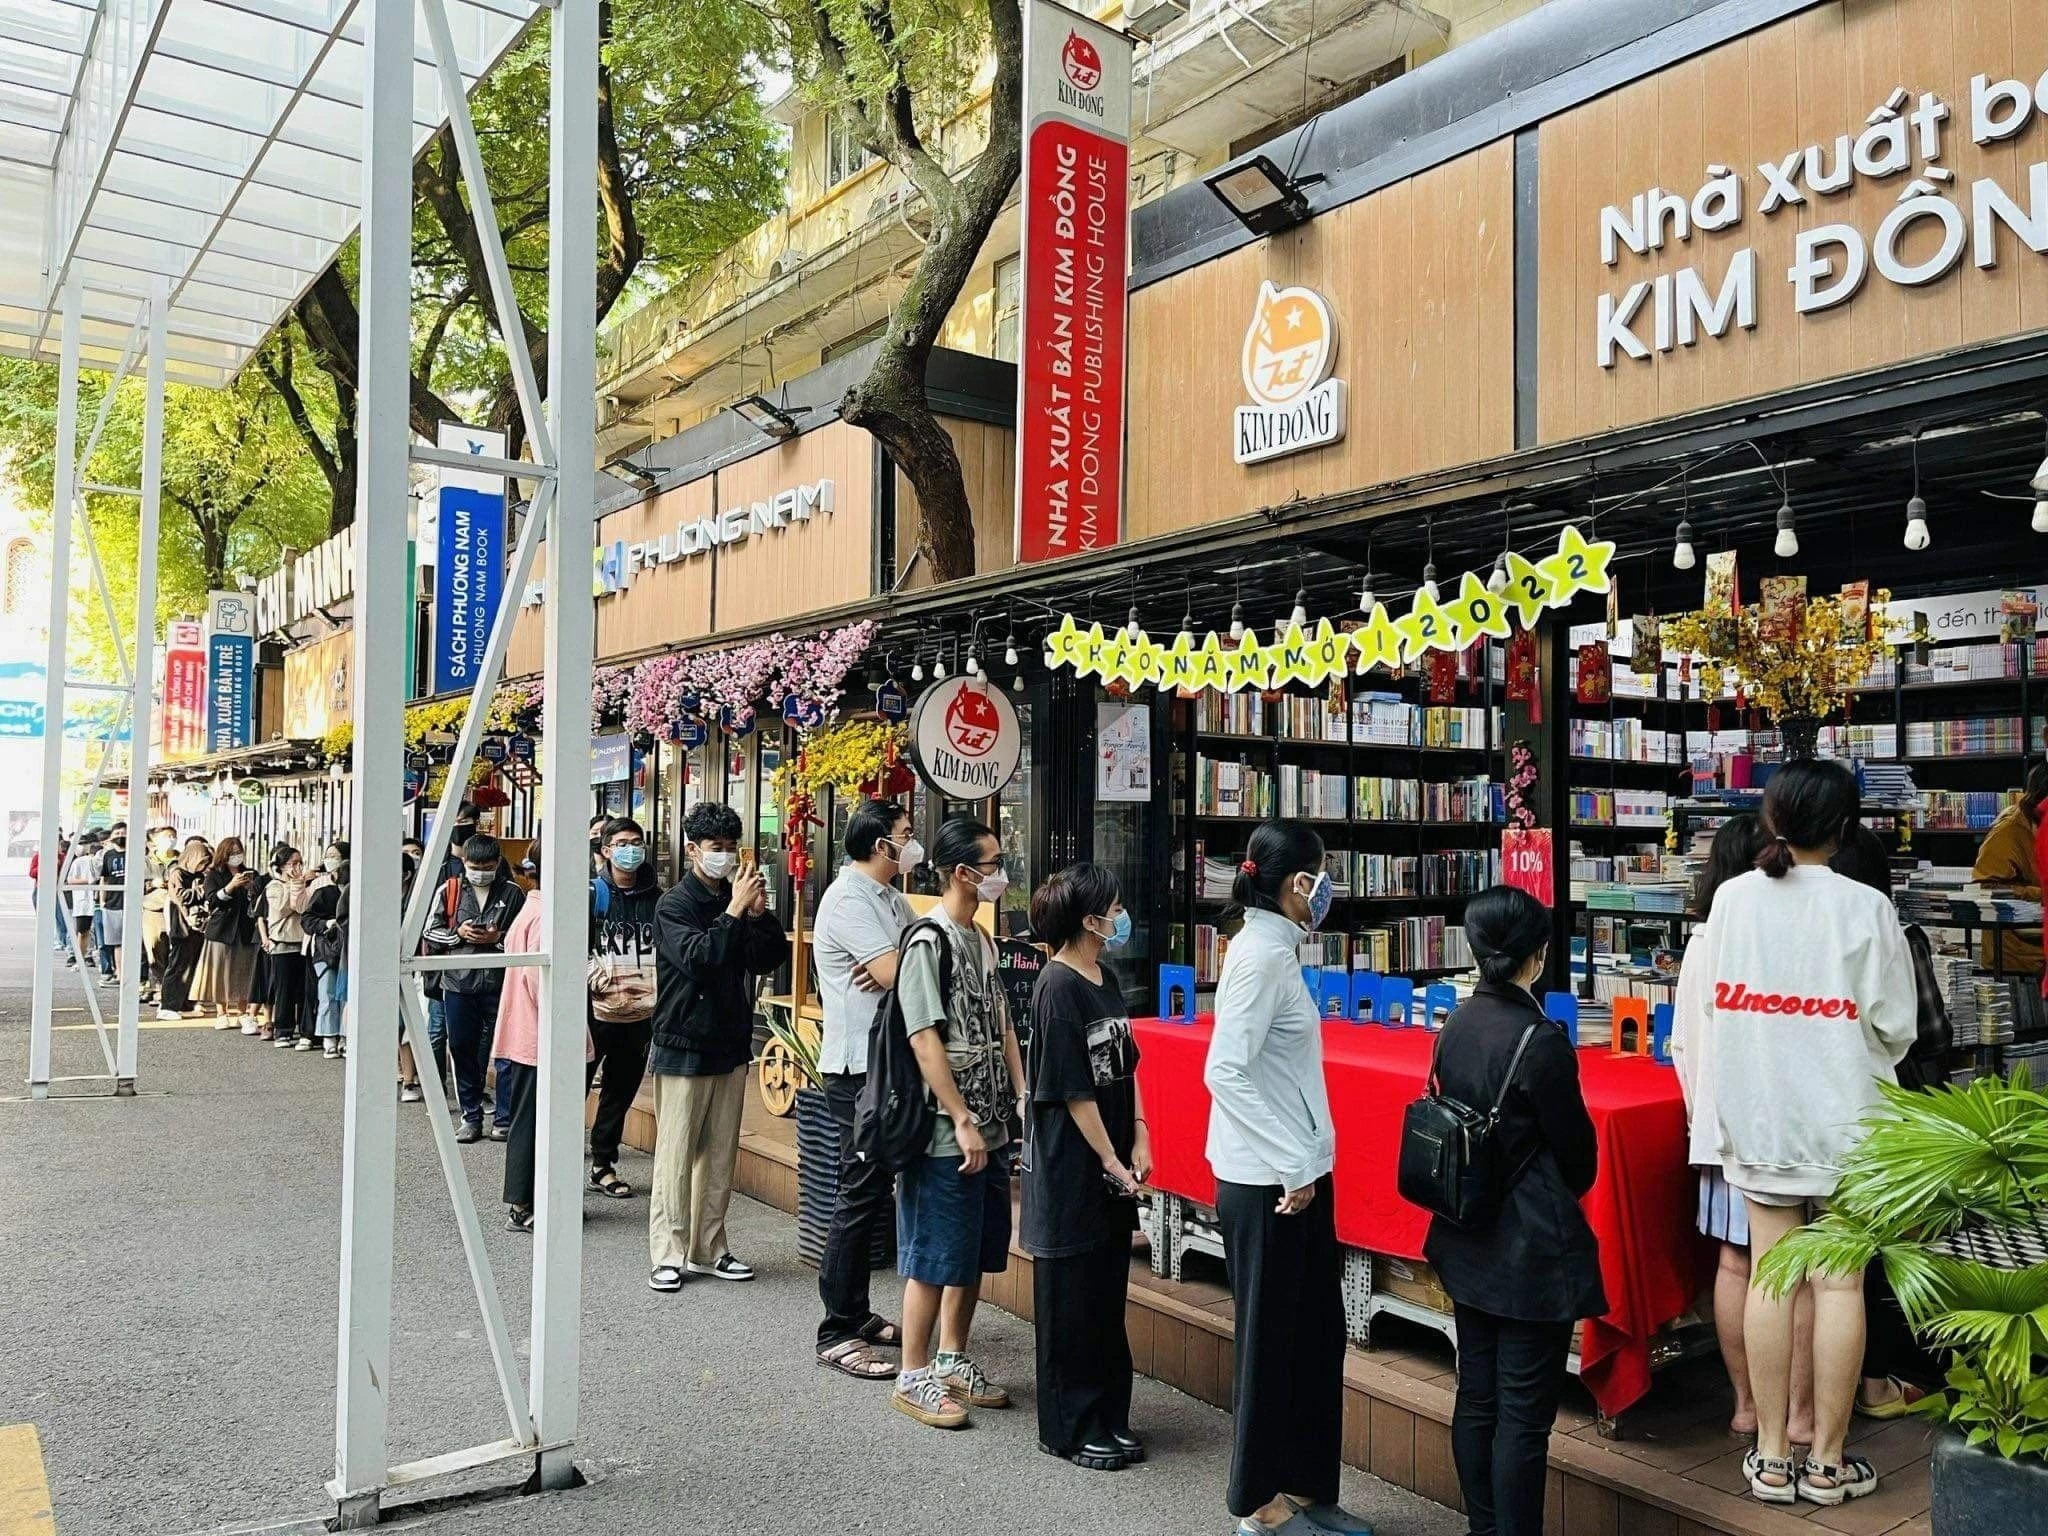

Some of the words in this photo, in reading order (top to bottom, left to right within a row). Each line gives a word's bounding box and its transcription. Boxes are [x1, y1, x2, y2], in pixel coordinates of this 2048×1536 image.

[1058, 78, 1077, 107] KIM
[1048, 143, 1078, 239] ĐỒNG
[1086, 154, 1107, 244] HOUSE
[1600, 164, 1743, 266] Nhà
[1756, 86, 1951, 214] xuất
[1054, 248, 1075, 306] KIM
[1597, 247, 1758, 369] KIM
[1786, 161, 2048, 314] ĐỒN
[1046, 315, 1074, 379] BẢN
[1083, 253, 1105, 405] PUBLISHING
[1044, 384, 1072, 469] XUẤT
[1239, 411, 1274, 456] KIM
[1081, 413, 1102, 496] DONG
[455, 510, 471, 553] NAM
[750, 478, 835, 535] NAM
[1046, 479, 1070, 547] NHÀ
[1079, 504, 1098, 551] KIM
[476, 527, 489, 567] BOOK
[453, 554, 470, 626] PHƯƠNG
[475, 570, 487, 603] NAM
[473, 608, 487, 665] PHUONG
[1062, 634, 1151, 671] CHÀO
[1174, 651, 1260, 675] NĂM
[1419, 554, 1588, 637] 2022
[1936, 607, 1977, 629] đến
[214, 644, 234, 667] TRẺ
[234, 644, 243, 673] HOUSE
[447, 628, 468, 678] SÁCH
[214, 667, 233, 693] BẢN
[233, 677, 243, 733] PUBLISHING
[213, 695, 233, 725] XUẤT
[932, 747, 961, 781] KIM
[1510, 850, 1544, 873] 10%
[1013, 951, 1040, 970] Hành
[1714, 981, 1859, 1021] Uncover
